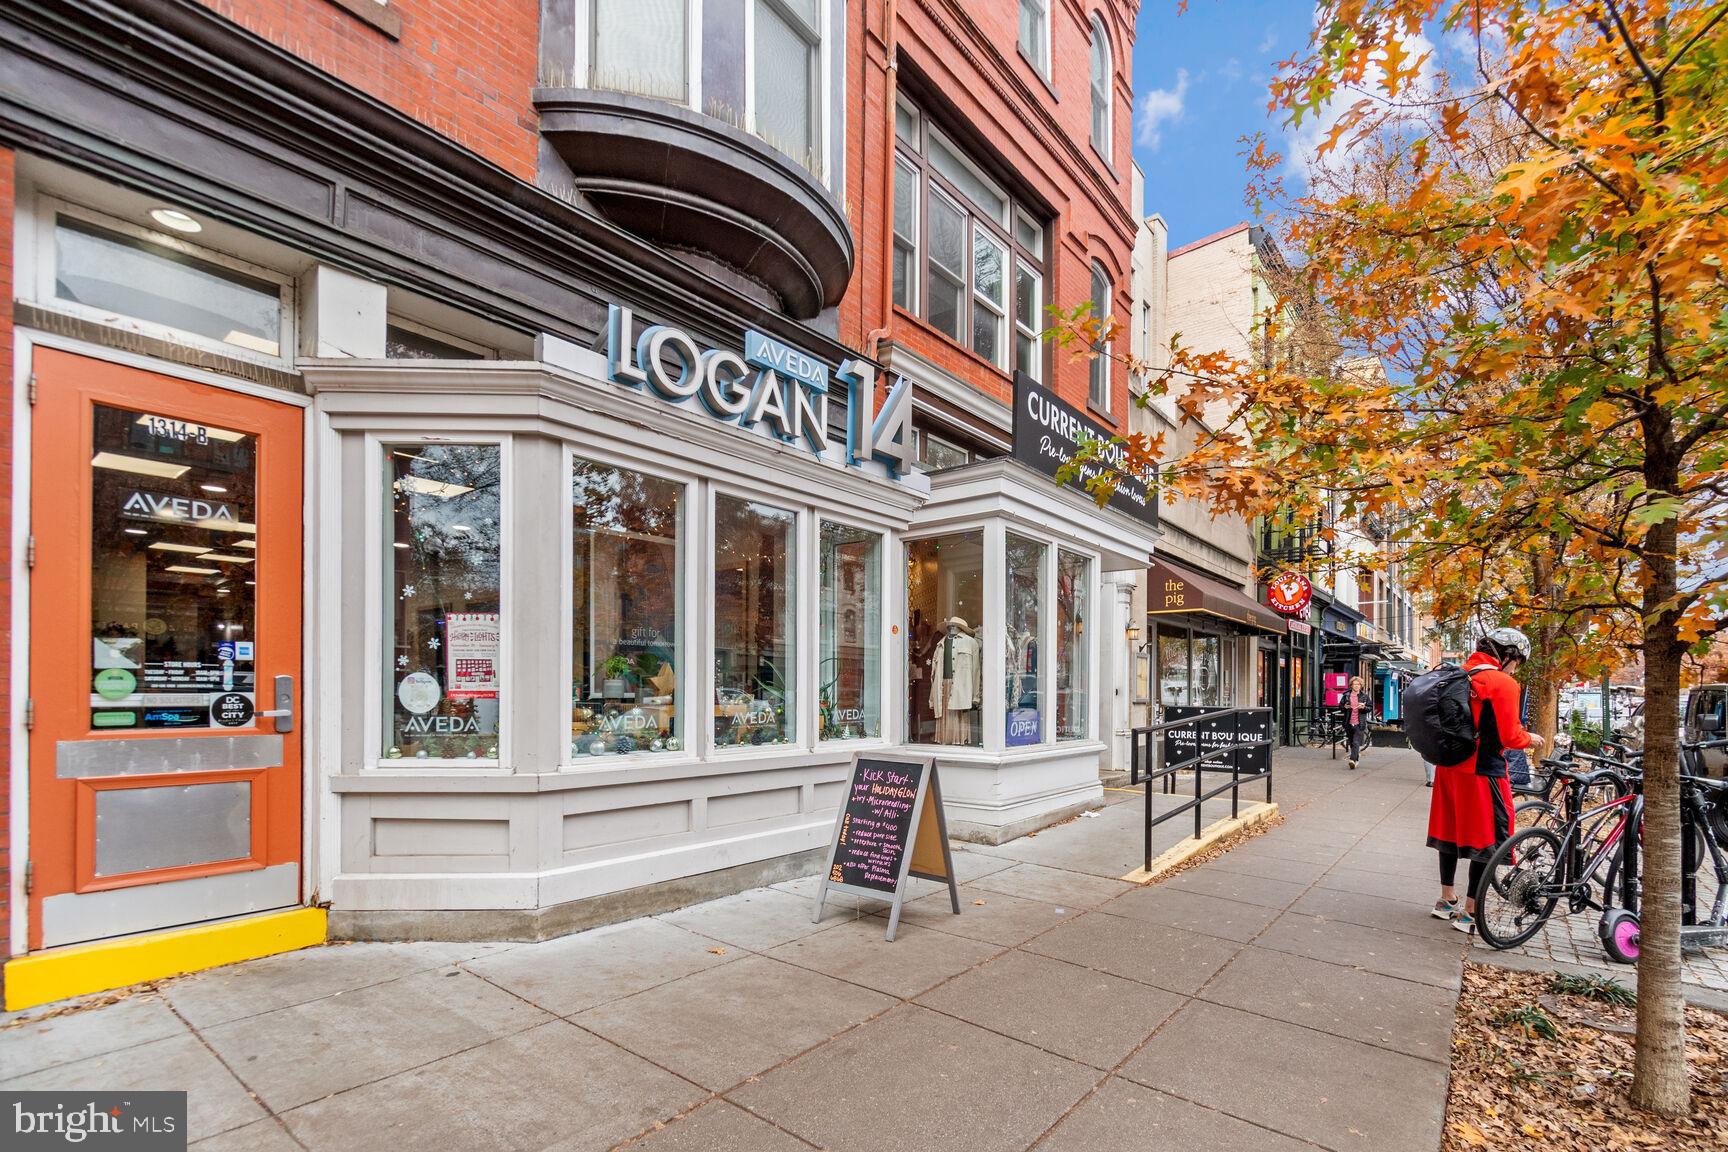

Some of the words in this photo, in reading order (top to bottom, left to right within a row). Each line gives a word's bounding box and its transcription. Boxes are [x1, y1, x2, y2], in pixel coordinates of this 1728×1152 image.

[756, 338, 825, 388] AVEDA
[608, 304, 828, 462] LOGAN
[836, 358, 913, 480] 14
[148, 417, 209, 446] 1314-B
[124, 491, 233, 524] AVEDA
[1165, 579, 1184, 592] the
[1165, 592, 1185, 607] pig
[1270, 597, 1306, 611] KITCHEN
[631, 626, 647, 639] gift
[226, 696, 240, 704] DC
[144, 713, 180, 721] AmSpa
[222, 711, 244, 719] CITY
[732, 711, 776, 725] AVEDA
[832, 709, 865, 721] AVEDA
[404, 716, 480, 733] AVEDA
[598, 715, 658, 731] AVEDA
[1010, 720, 1038, 737] OPEN
[854, 783, 870, 795] your
